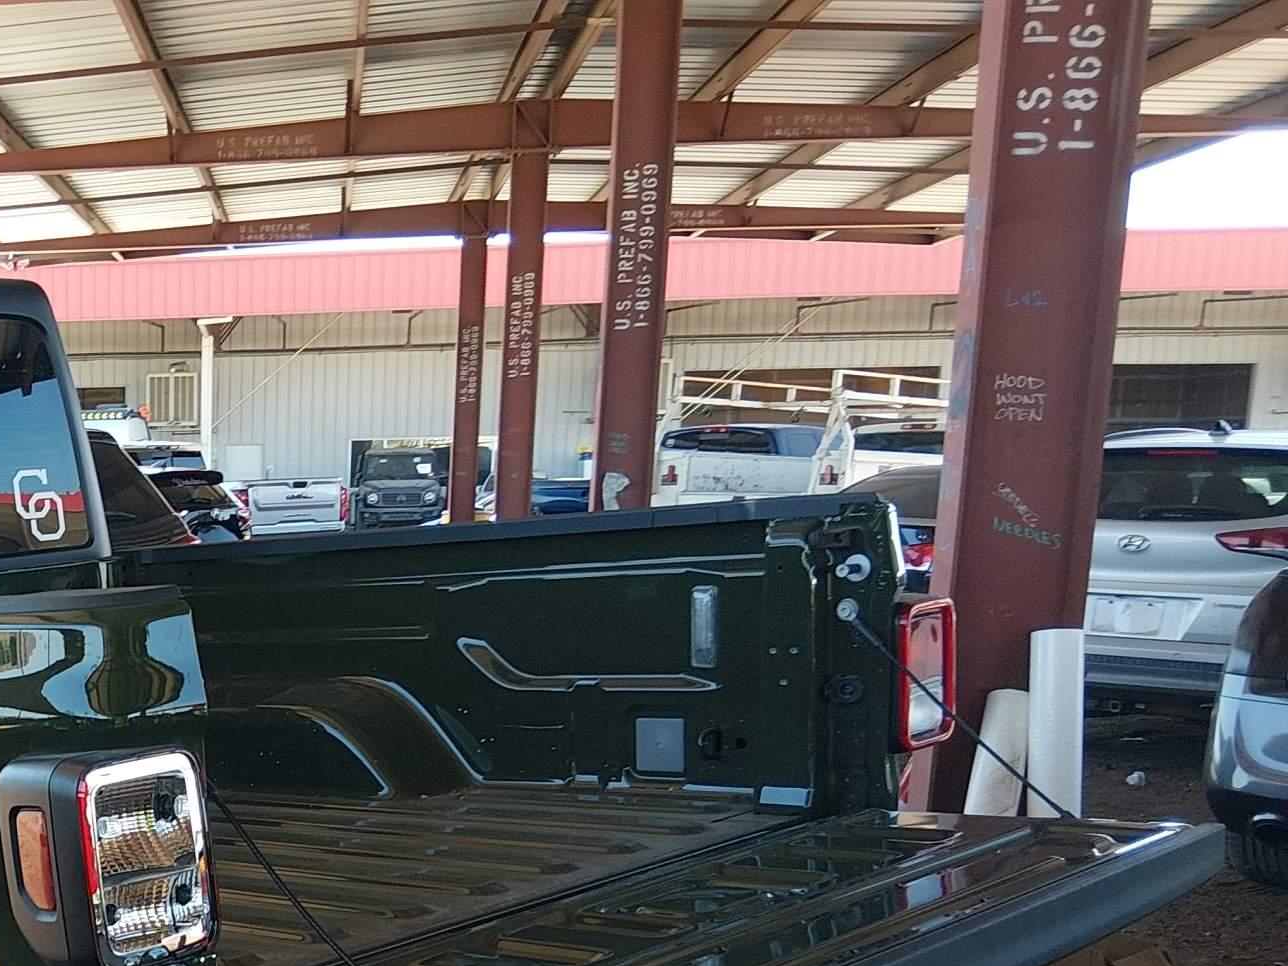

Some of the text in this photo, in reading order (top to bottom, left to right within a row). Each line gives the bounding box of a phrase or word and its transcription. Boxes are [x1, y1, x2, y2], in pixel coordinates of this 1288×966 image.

[1012, 73, 1056, 155] U.S.
[613, 162, 641, 330] U.S. PREFAB INC.
[633, 163, 659, 328] 1-866-799-0969
[508, 301, 522, 349] PREFAB
[459, 347, 470, 382] PREFAB
[507, 354, 520, 378] U.S.
[994, 373, 1045, 389] HOOD
[994, 406, 1044, 421] OPEN
[996, 392, 1047, 406] WONT
